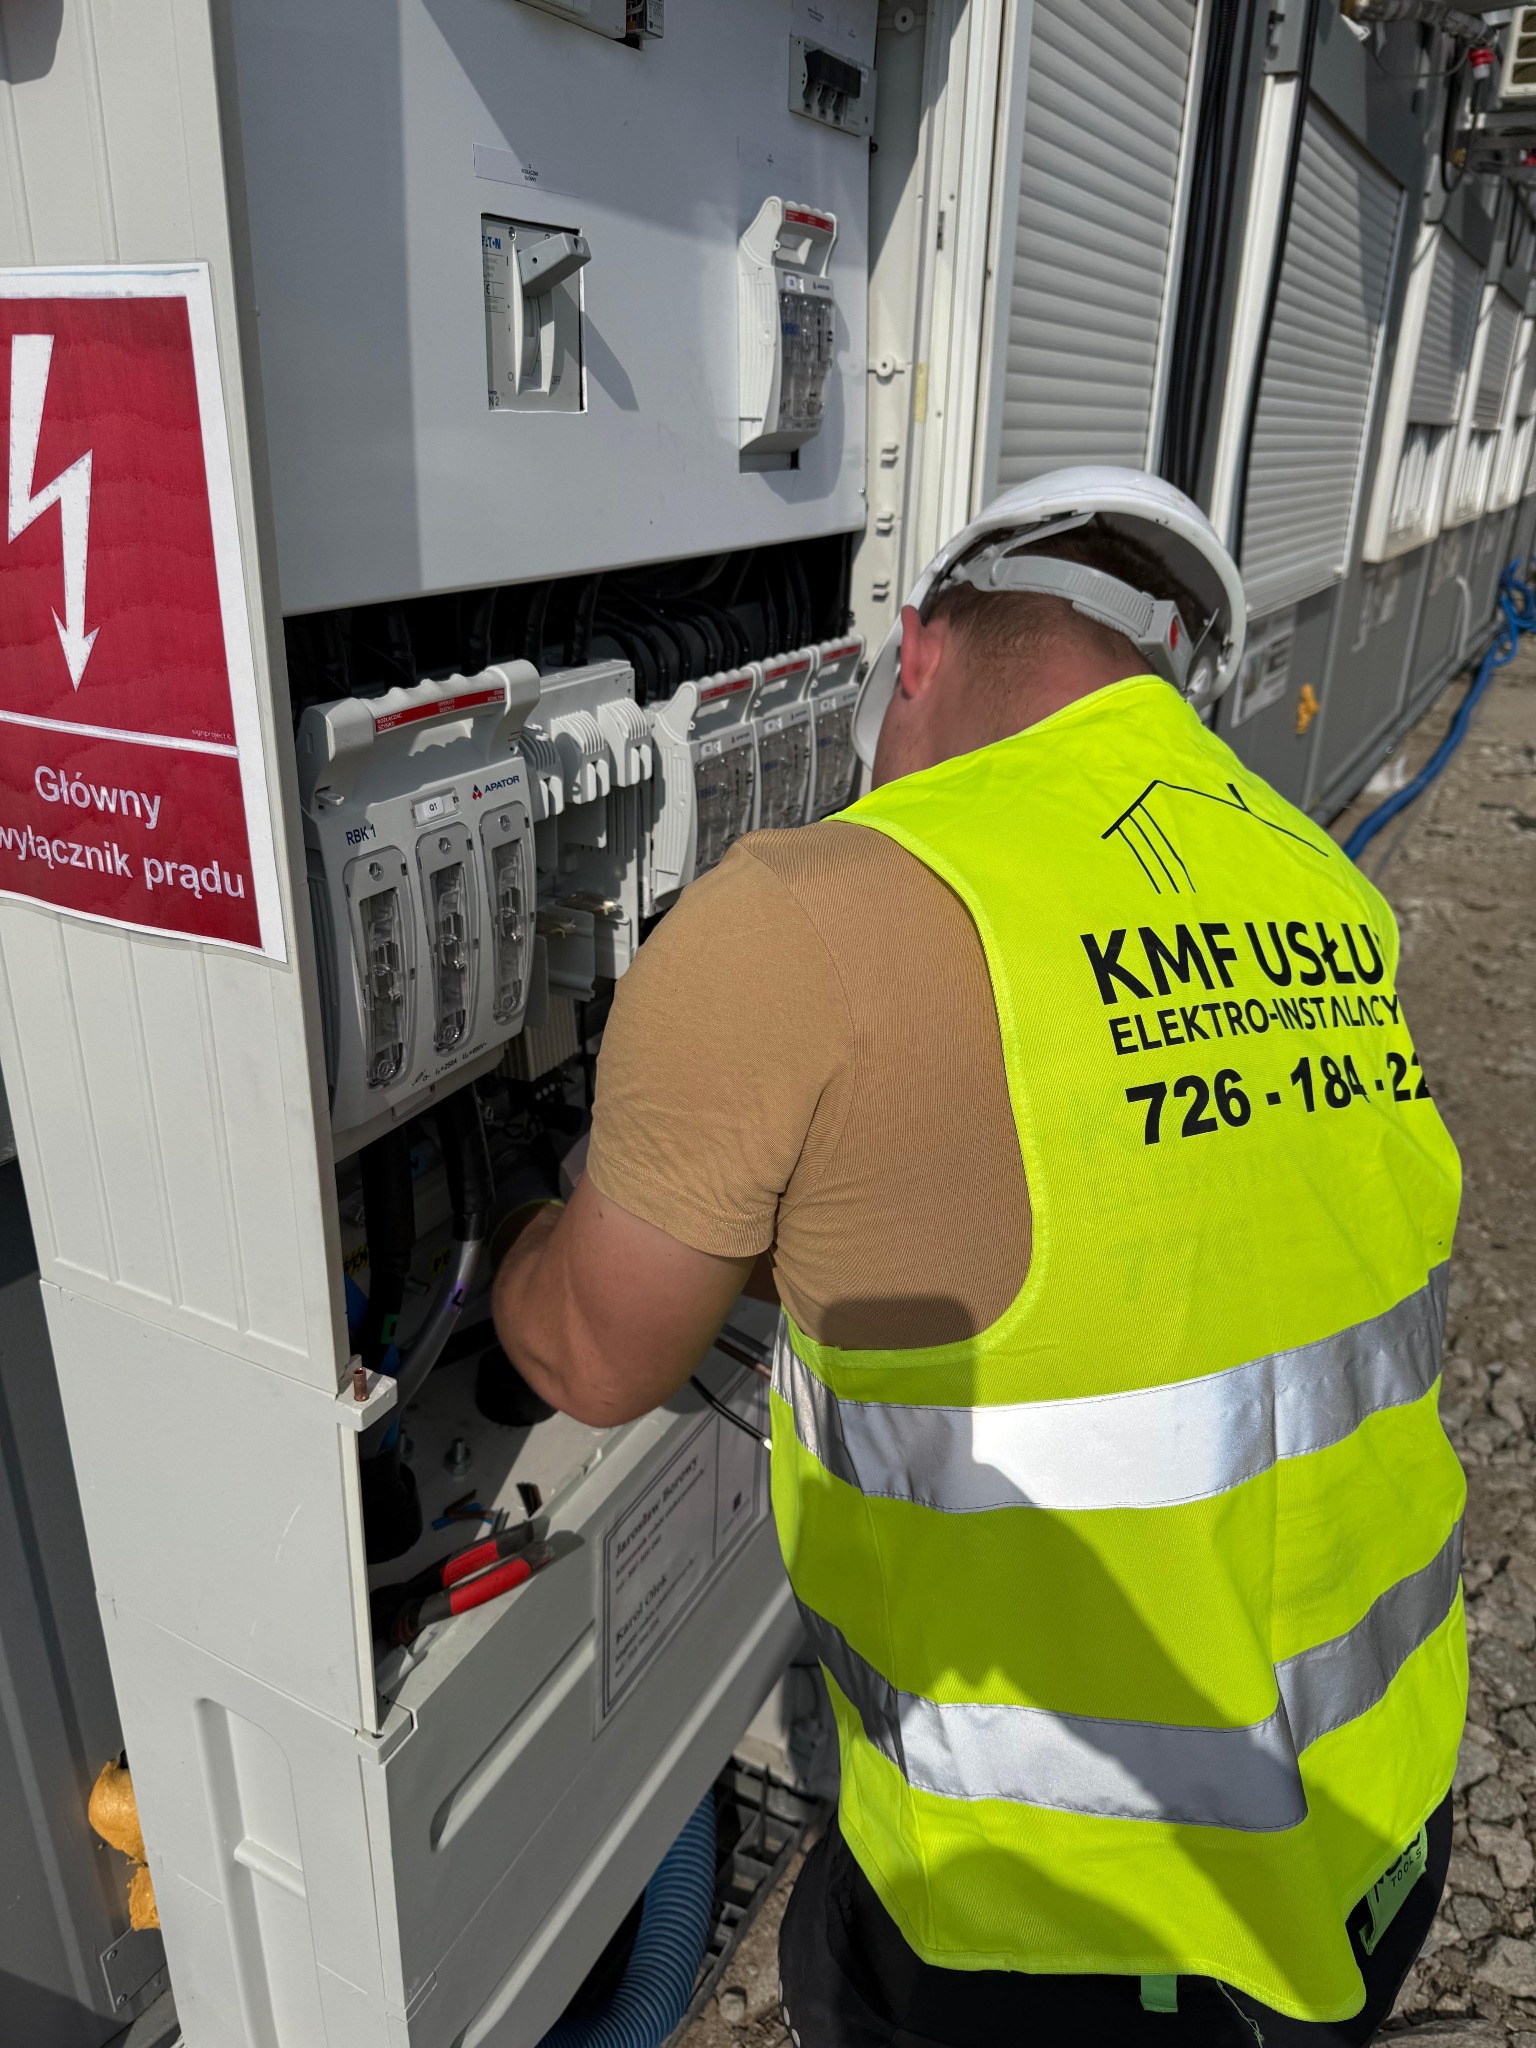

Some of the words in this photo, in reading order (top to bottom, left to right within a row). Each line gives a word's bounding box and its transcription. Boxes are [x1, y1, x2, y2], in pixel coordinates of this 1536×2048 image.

[34, 765, 162, 830] Główny
[484, 775, 520, 794] APATOR
[345, 826, 369, 847] RBK
[370, 823, 377, 838] 1
[143, 857, 245, 899] prądu
[1080, 922, 1238, 1006] KMF
[1245, 921, 1385, 987] USŁU
[1108, 993, 1400, 1056] ELEKTRO-INSTALACY
[1125, 1067, 1252, 1146] 726
[1390, 1846, 1422, 1888] TOOLS
